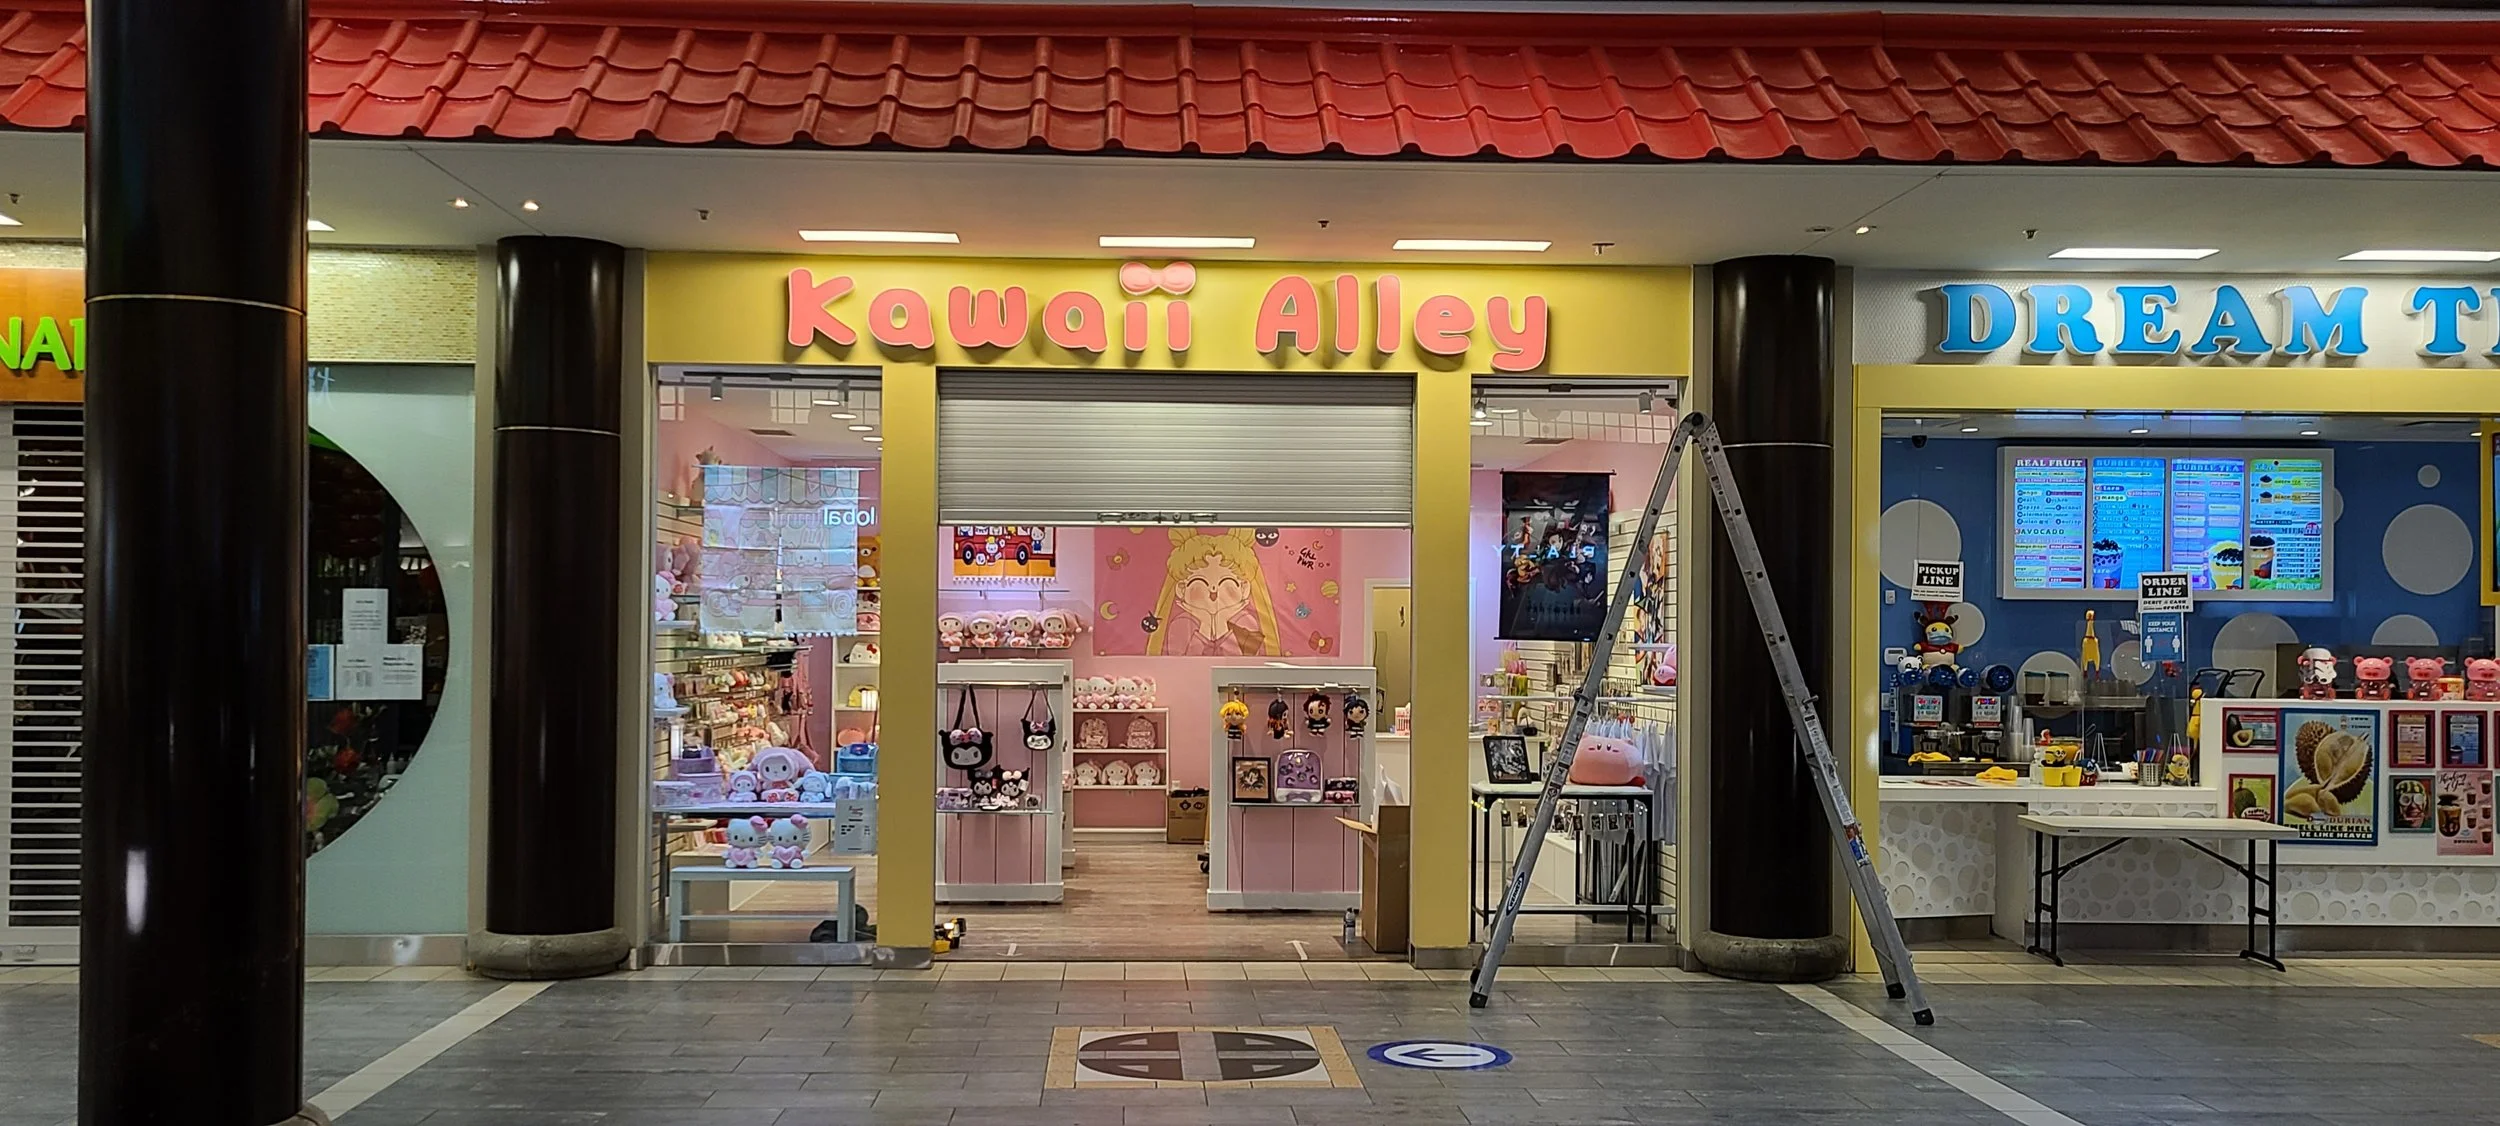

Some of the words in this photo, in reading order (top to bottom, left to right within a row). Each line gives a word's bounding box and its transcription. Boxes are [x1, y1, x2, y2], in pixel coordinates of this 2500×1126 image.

[787, 262, 1192, 353] Kawaii
[1255, 273, 1548, 371] Alley
[1939, 283, 2369, 355] DREAM
[2412, 285, 2500, 355] T
[2017, 459, 2046, 467] REAL
[2049, 459, 2083, 467] FRUIT
[2096, 459, 2135, 467] BUBBLE
[2140, 459, 2160, 467] TEA
[2176, 463, 2214, 471] BUBBLE
[2219, 463, 2240, 471] TEA
[1918, 566, 1959, 575] PICKUP
[1922, 575, 1954, 586] LINE
[2143, 577, 2187, 586] ORDER
[2147, 587, 2182, 597] LINE
[2319, 824, 2345, 832] LIKE
